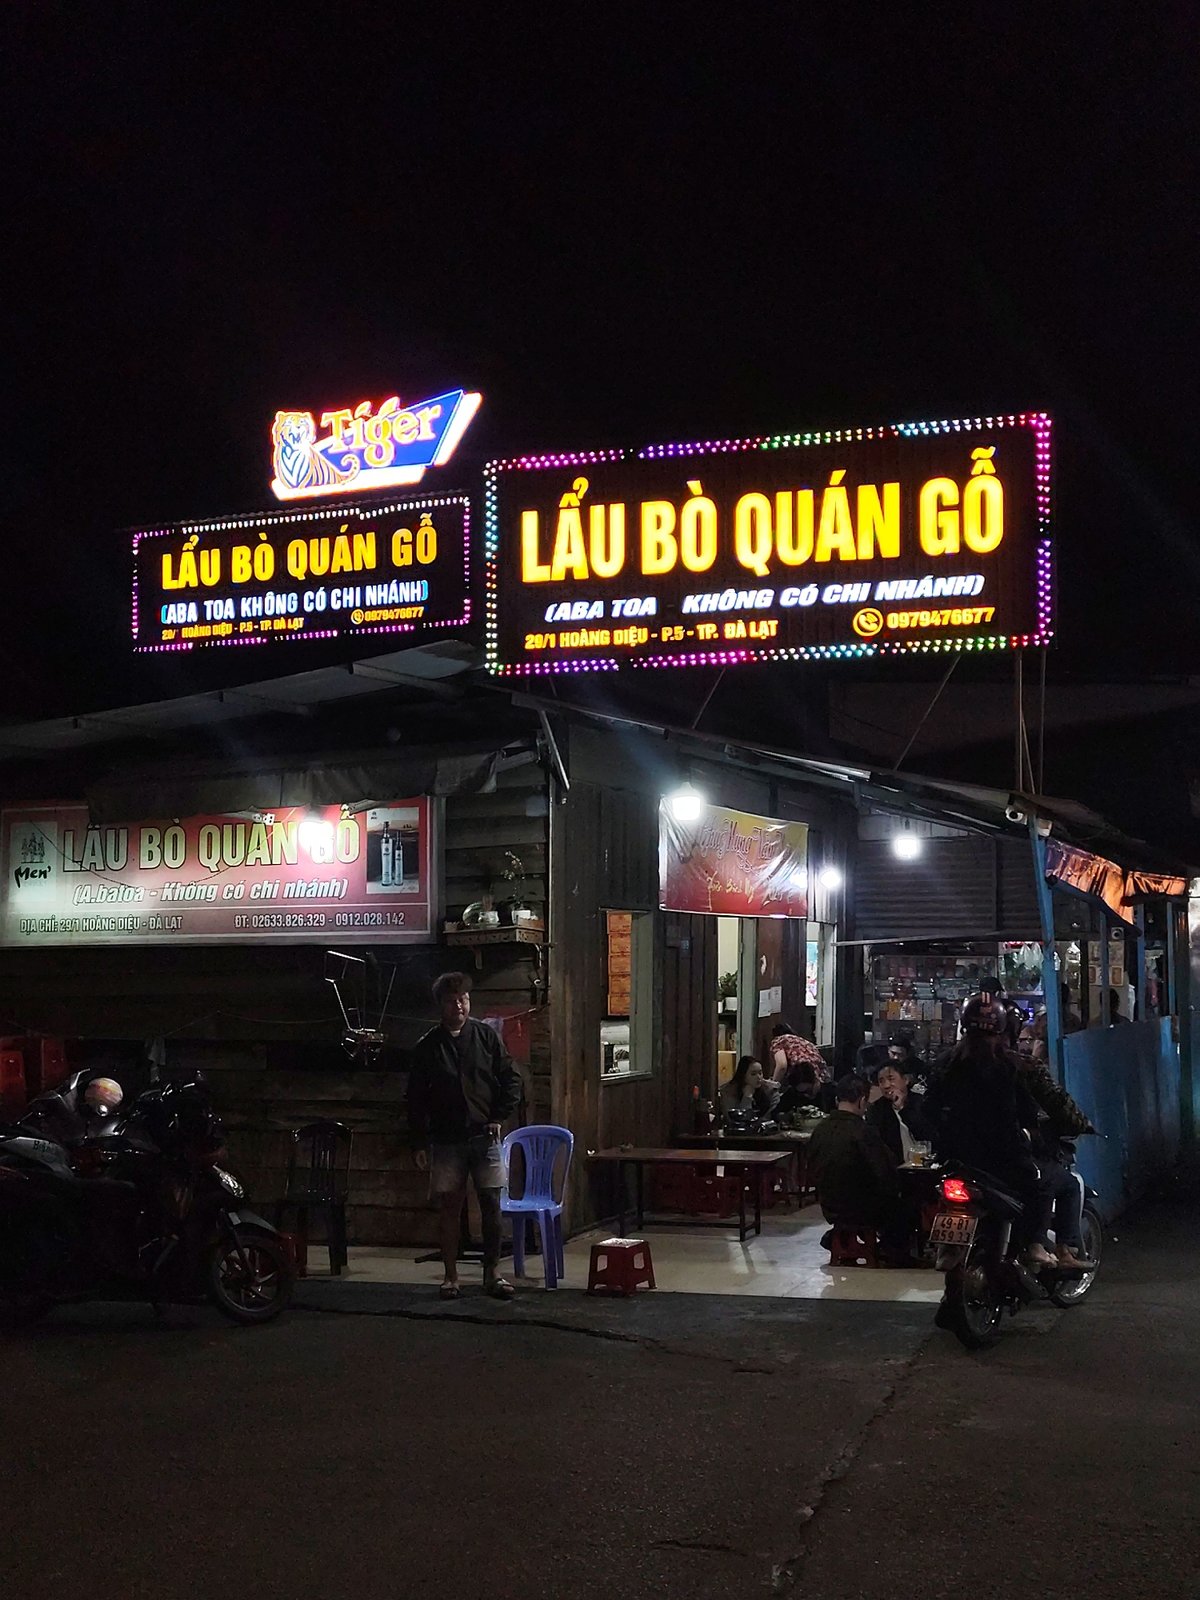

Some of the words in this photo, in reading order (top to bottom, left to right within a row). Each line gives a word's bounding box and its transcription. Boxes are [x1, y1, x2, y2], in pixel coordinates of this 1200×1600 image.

[320, 397, 442, 467] Tiger
[521, 476, 626, 583] LẨU
[641, 479, 718, 576] BÒ
[735, 469, 900, 577] QUÁN
[919, 446, 1004, 556] GỖ
[162, 534, 220, 590] LẨU
[231, 533, 274, 584] BÒ
[287, 524, 377, 580] QUÁN
[391, 512, 438, 567] GỖ
[160, 602, 198, 625] (ABA
[204, 598, 235, 620] TOA
[240, 592, 298, 617] KHÔNG
[303, 586, 326, 613] CÓ
[330, 586, 361, 609] CHI
[365, 579, 428, 606] NHÁNH)
[544, 600, 604, 623] (ABA
[611, 596, 657, 617] TOA
[682, 588, 774, 614] KHÔNG
[779, 583, 819, 607] CÓ
[822, 581, 872, 604] CHI
[874, 574, 985, 601] NHÁNH)
[886, 606, 996, 629] 0979476677
[524, 633, 556, 650] 29/1
[559, 628, 611, 647] HOÀNG
[613, 626, 648, 647] DIỆU
[661, 625, 685, 641] P.5
[697, 623, 718, 640] TP.
[724, 619, 747, 639] ĐÀ
[749, 619, 779, 640] LẠT
[139, 817, 187, 871] BÒ
[222, 880, 244, 900] có
[249, 878, 279, 900] chi
[283, 878, 349, 900] nhánh)
[82, 916, 116, 931] HOÀNG
[118, 914, 140, 934] DIỆU
[148, 914, 163, 930] ĐÀ
[165, 917, 183, 933] LẠT
[252, 912, 325, 928] 02633.826.329
[335, 912, 405, 926] 0912.028.142
